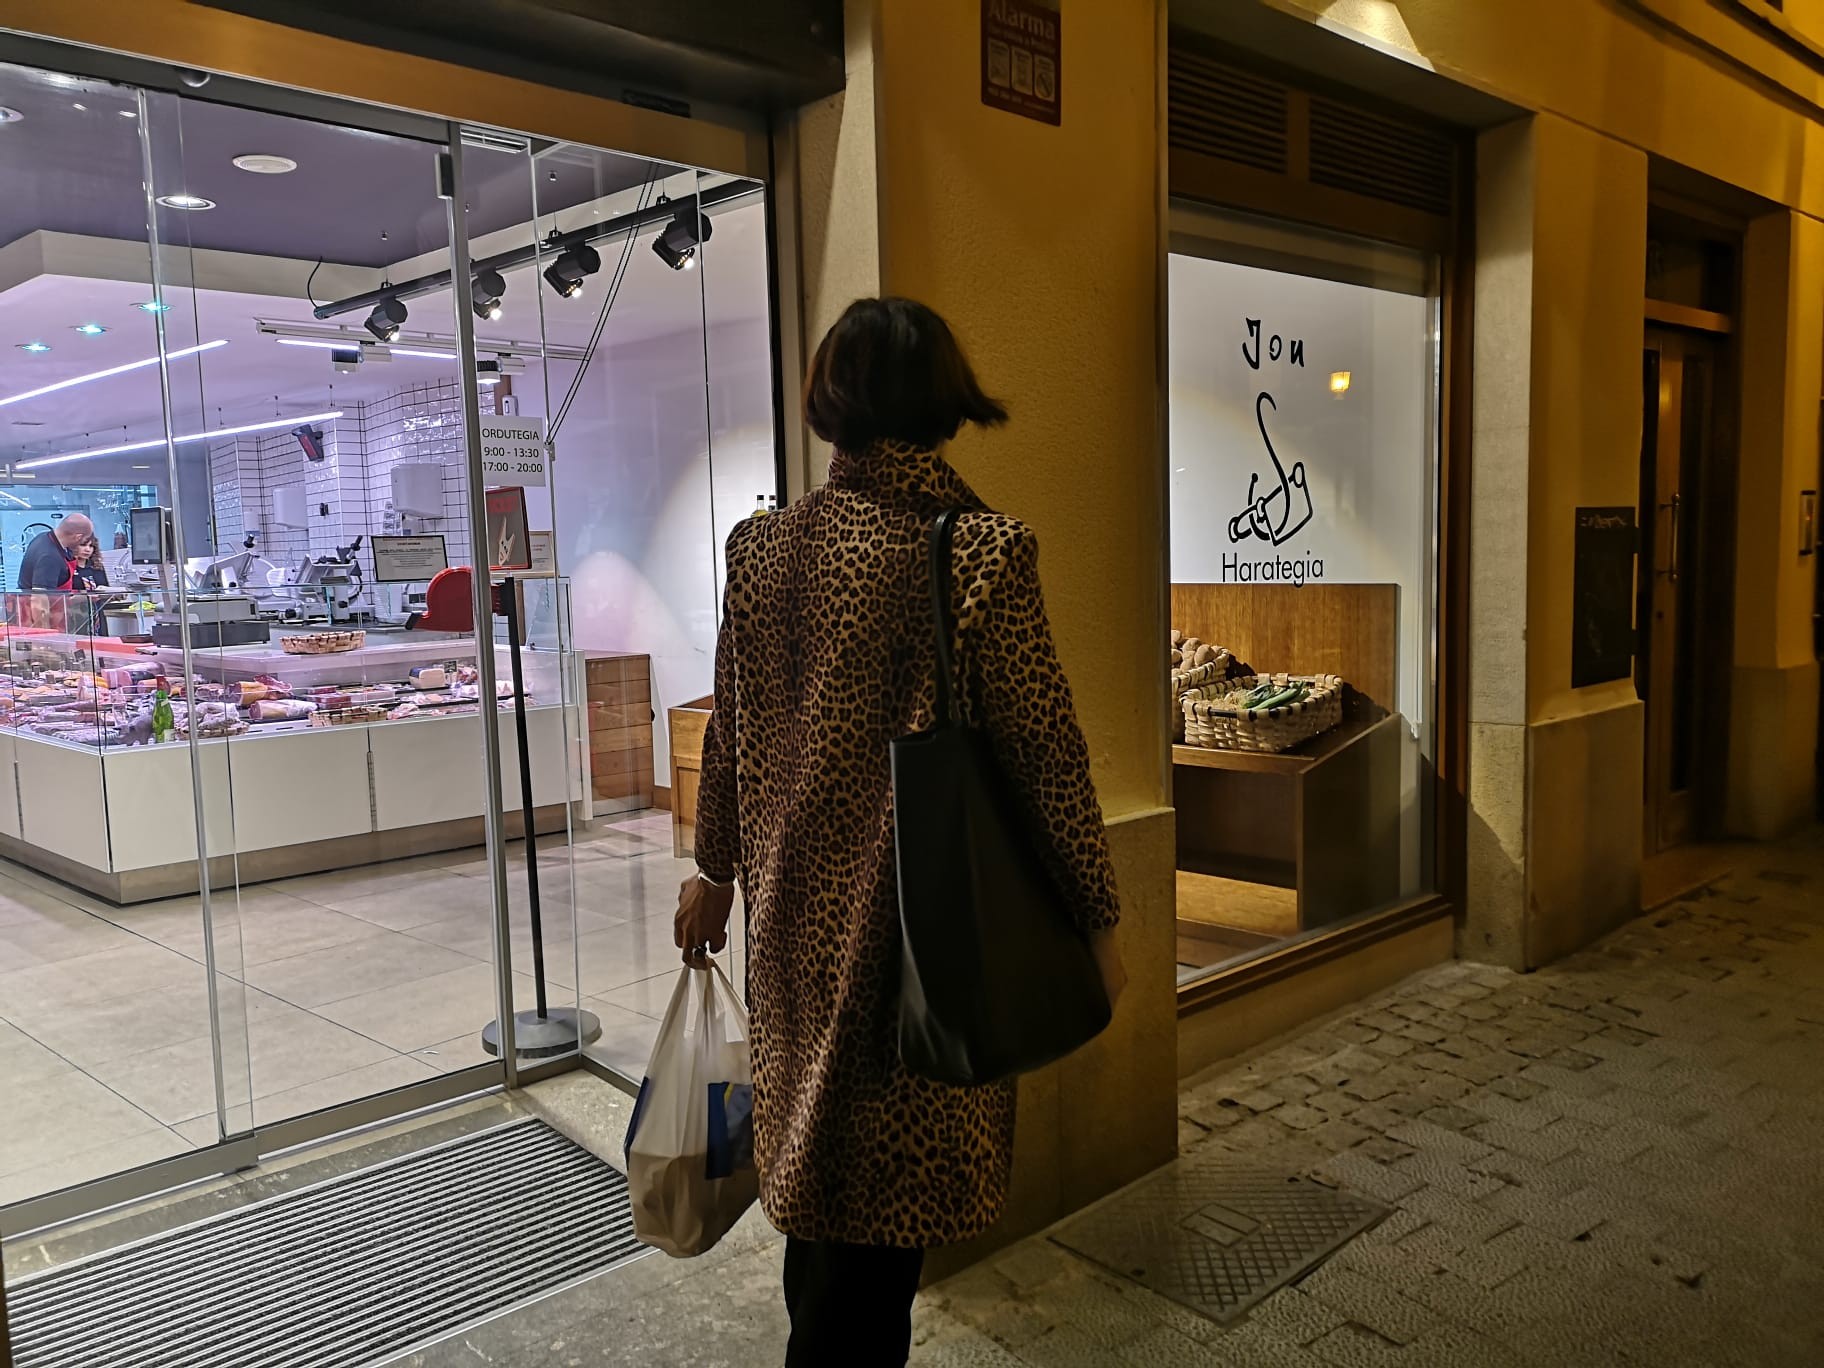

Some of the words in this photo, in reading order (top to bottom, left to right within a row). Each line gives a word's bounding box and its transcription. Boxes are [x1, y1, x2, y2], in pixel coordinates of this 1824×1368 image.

[1242, 317, 1305, 370] Jon
[482, 428, 539, 440] ORDUTEGIA
[484, 446, 505, 457] 9:00
[513, 447, 539, 458] 13:30
[482, 461, 509, 472] 17:00
[516, 463, 543, 473] 20:00
[1222, 550, 1324, 589] Harategia
